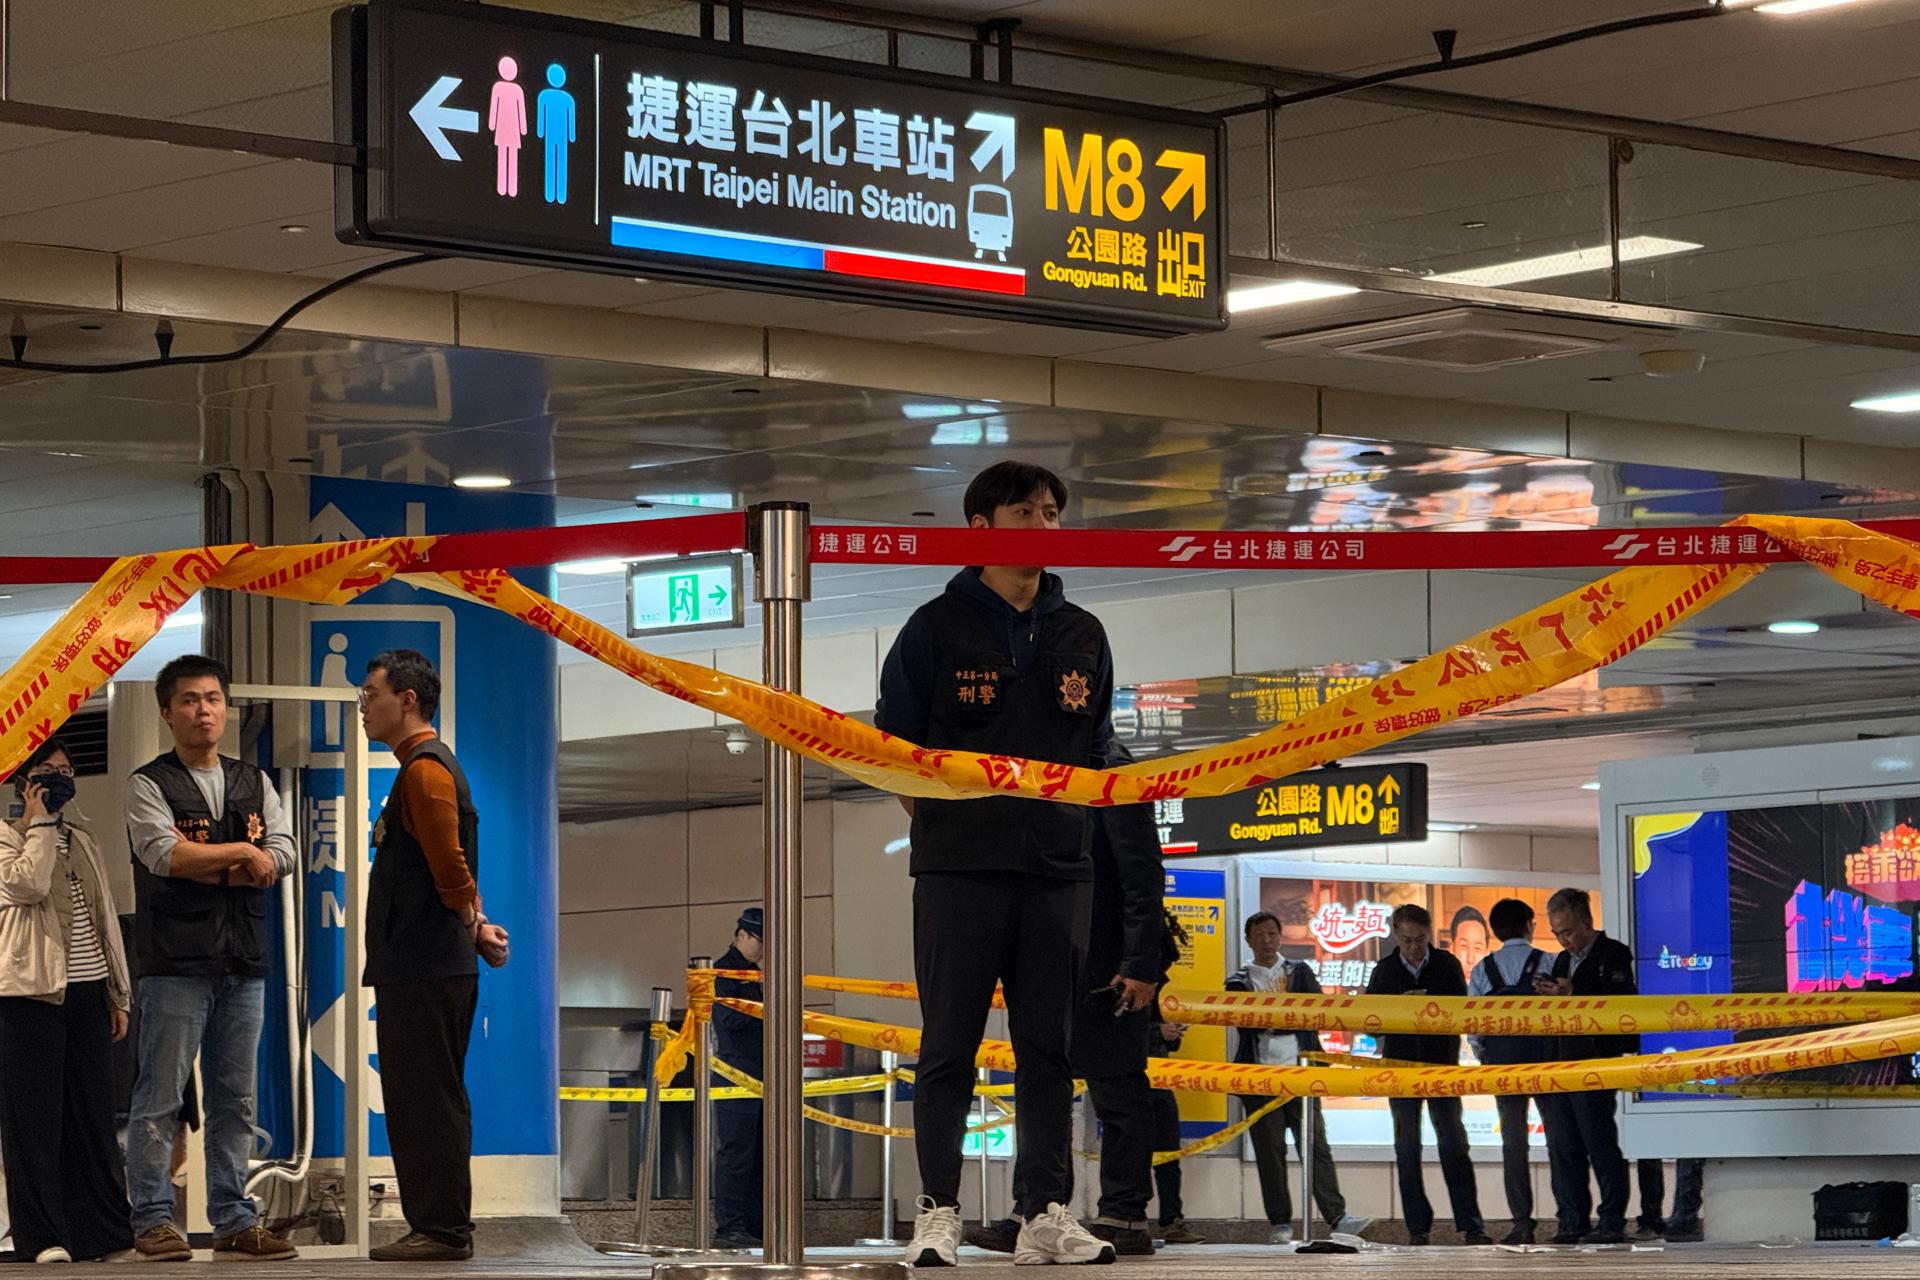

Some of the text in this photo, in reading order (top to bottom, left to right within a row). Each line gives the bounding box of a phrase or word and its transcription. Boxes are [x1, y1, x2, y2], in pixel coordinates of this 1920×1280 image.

[626, 72, 955, 183] 捷運台北車站
[624, 151, 956, 229] MRT Taipei Main Station
[1043, 127, 1146, 222] M8
[1066, 226, 1148, 268] 公園路
[1157, 228, 1206, 298] 出口
[1042, 261, 1148, 292] Gongyuan Rd.
[1181, 279, 1206, 299] EXIT
[818, 532, 917, 555] 捷運公司
[1213, 539, 1365, 561] 台北捷運公司
[957, 684, 996, 705] 刑警
[1154, 798, 1185, 825] 運
[1255, 784, 1321, 818] 公園路
[1326, 783, 1375, 827] M8
[1230, 817, 1322, 842] Gongyuan Rd.
[1314, 904, 1387, 939] 統一麵
[1539, 1014, 1603, 1035] 禁止進入
